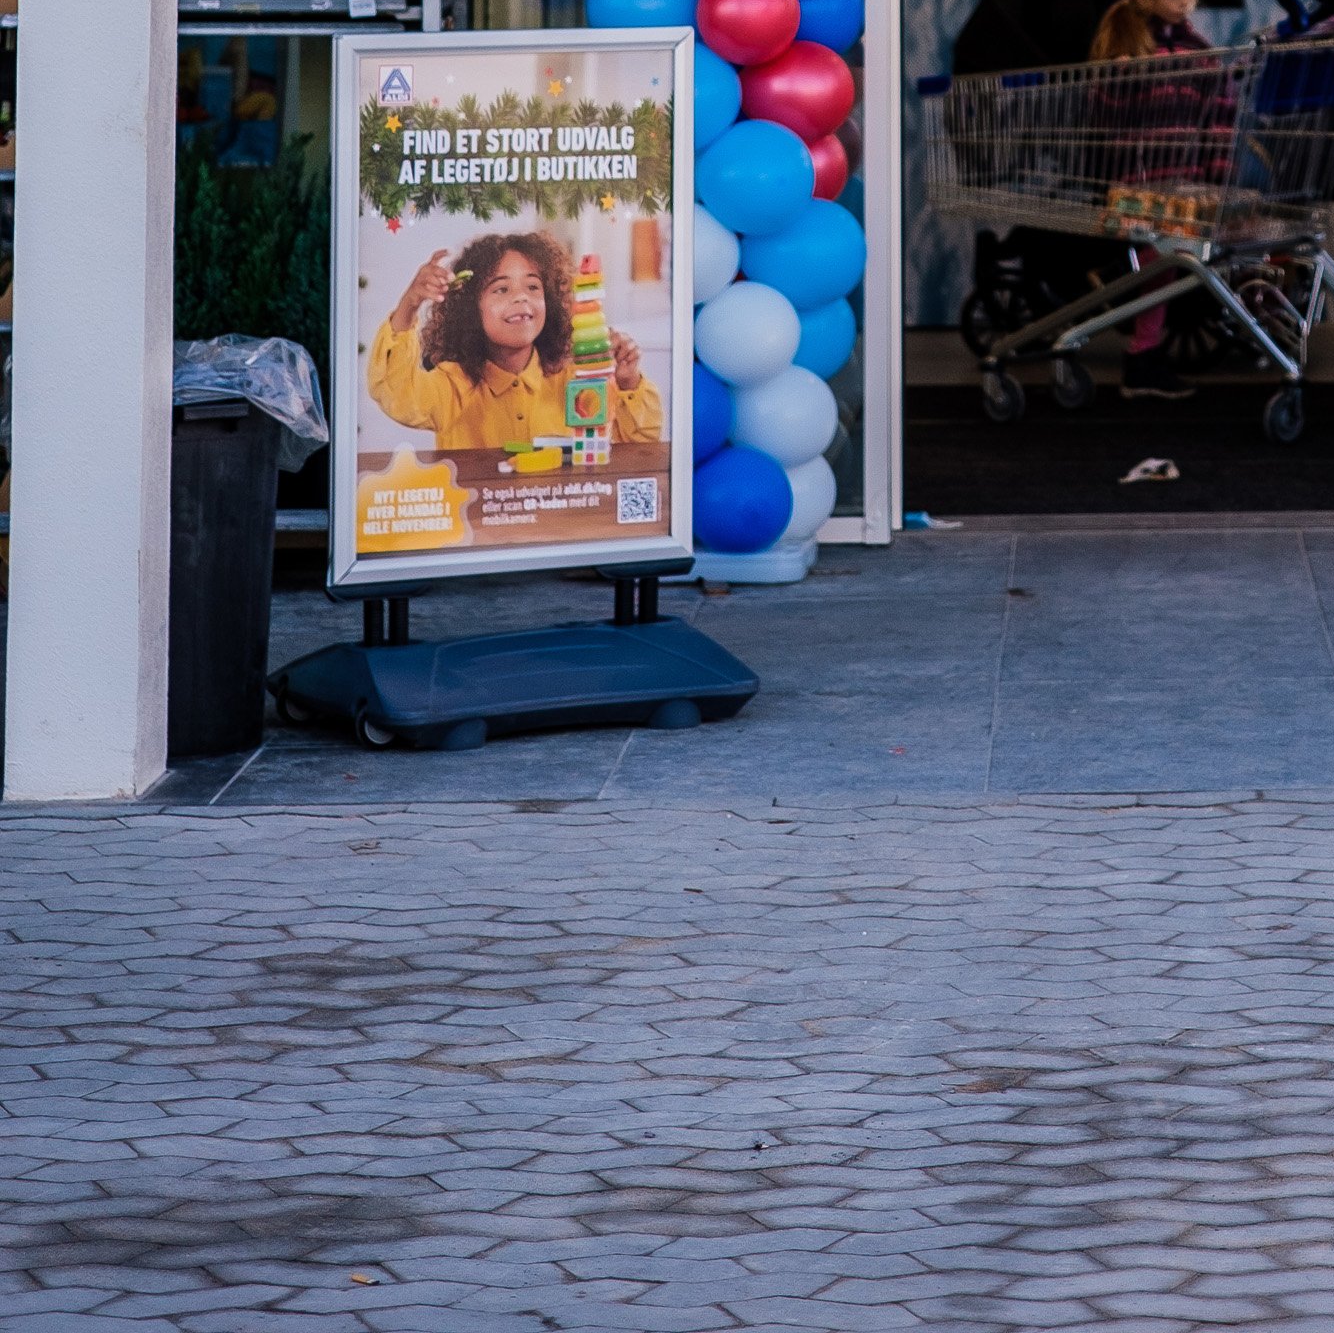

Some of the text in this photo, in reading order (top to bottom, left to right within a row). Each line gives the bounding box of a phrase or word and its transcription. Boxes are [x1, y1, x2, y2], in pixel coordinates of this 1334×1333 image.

[402, 126, 634, 155] FIND ET STORT UDVALG
[398, 155, 637, 184] AF LEGETØJ I BUTIKKEN
